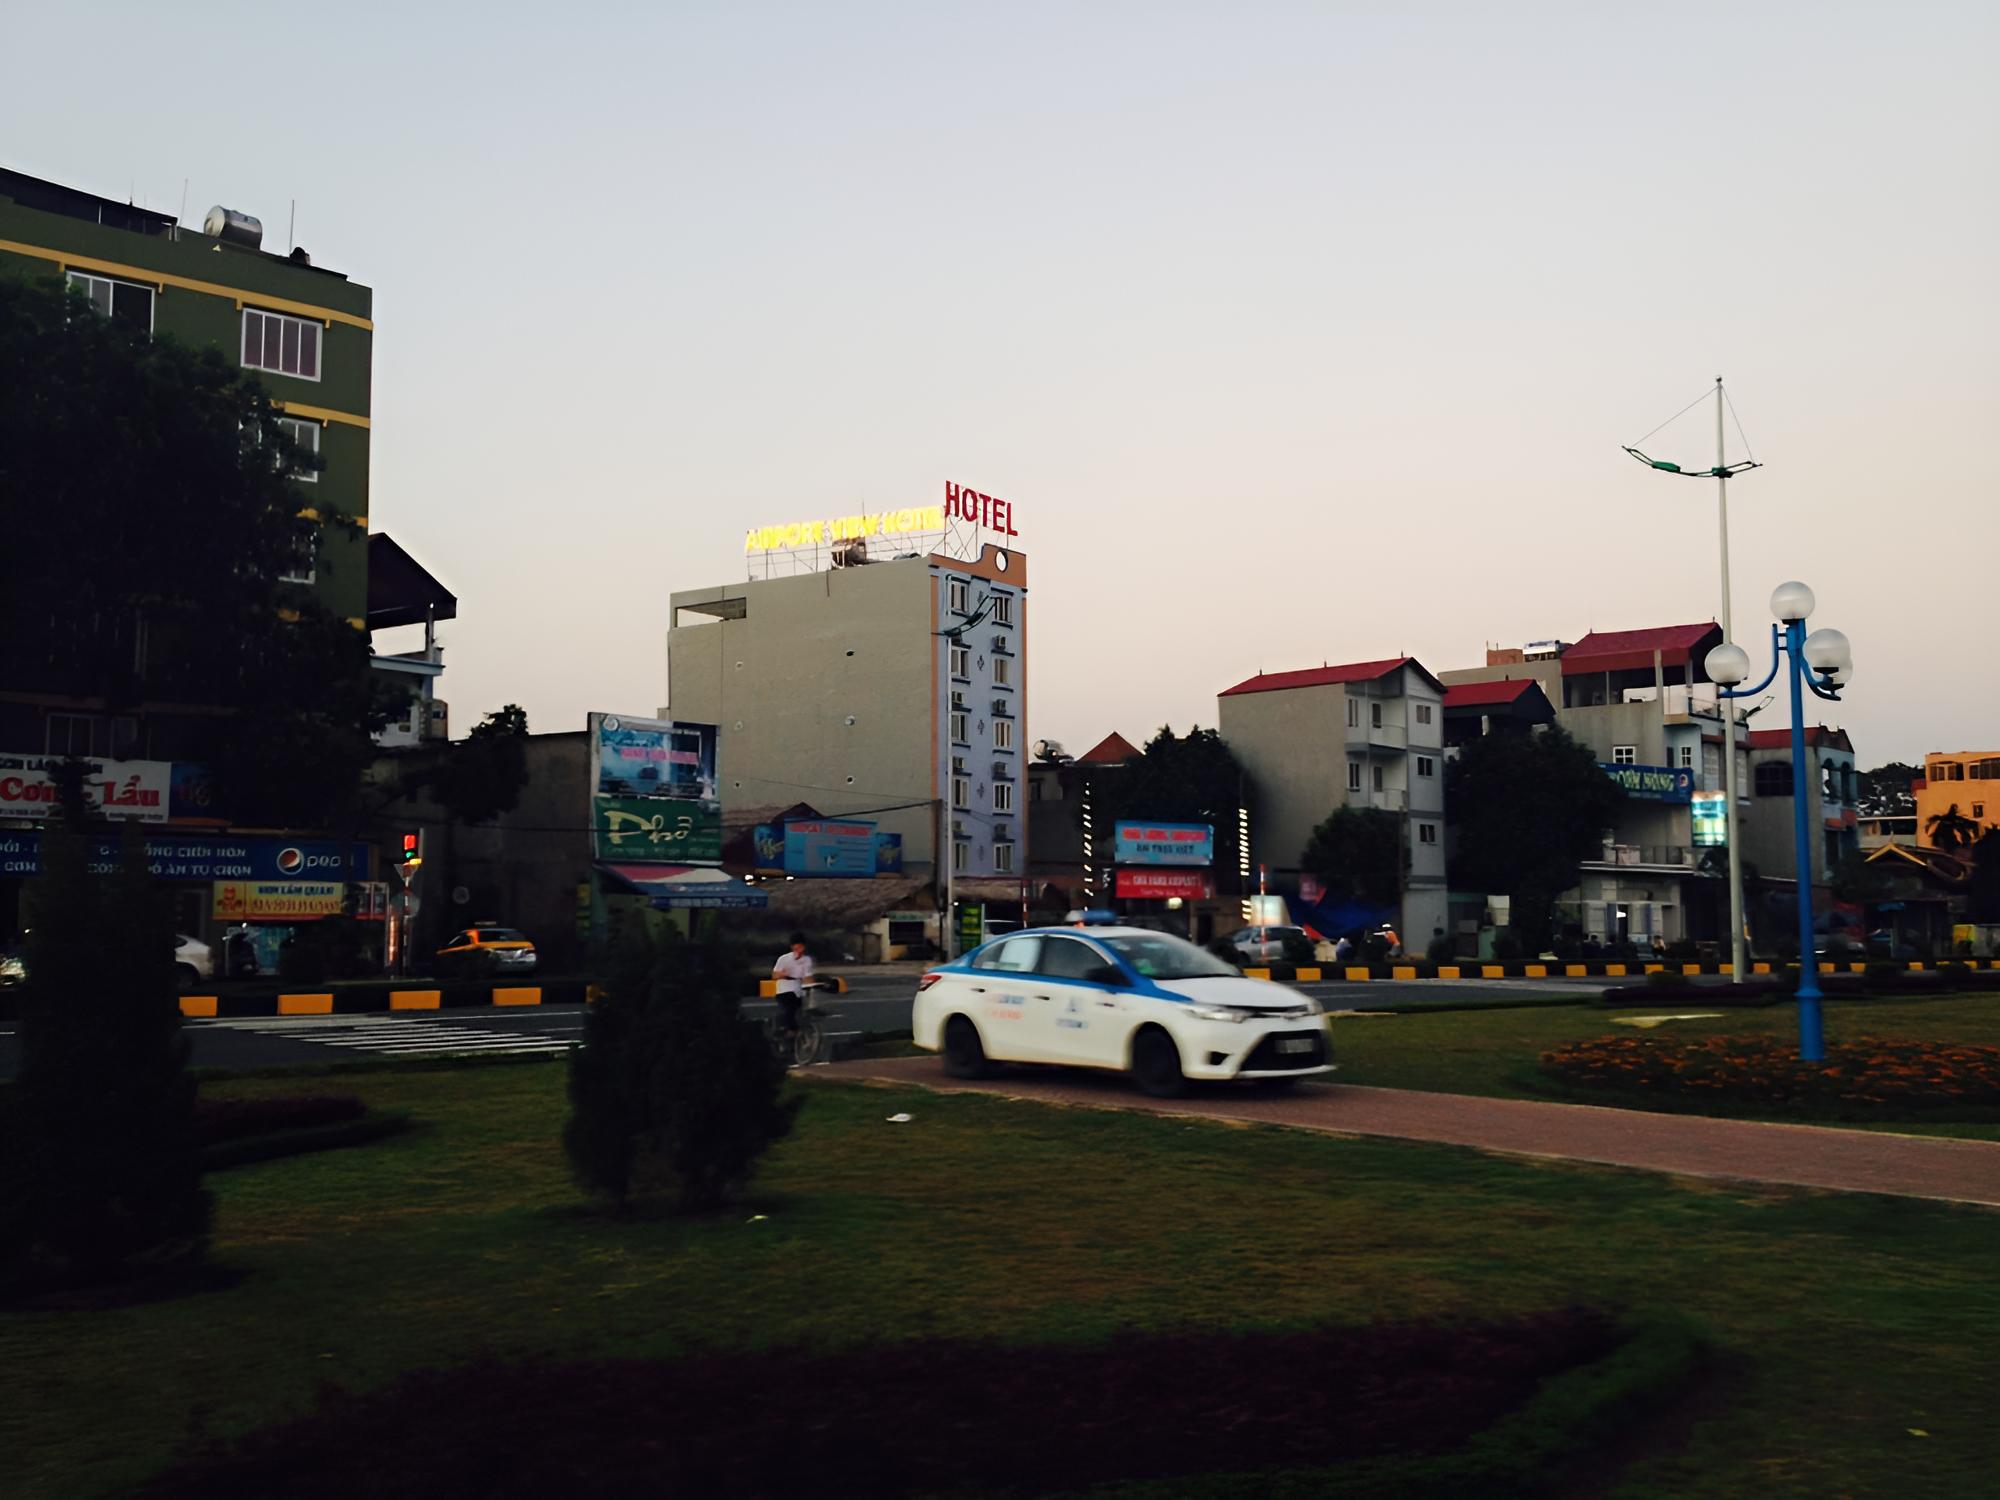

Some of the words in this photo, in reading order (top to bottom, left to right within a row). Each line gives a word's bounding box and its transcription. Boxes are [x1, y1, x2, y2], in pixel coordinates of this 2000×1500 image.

[945, 480, 1018, 537] HOTEL
[103, 775, 160, 806] Lẩu
[307, 855, 354, 868] pepi
